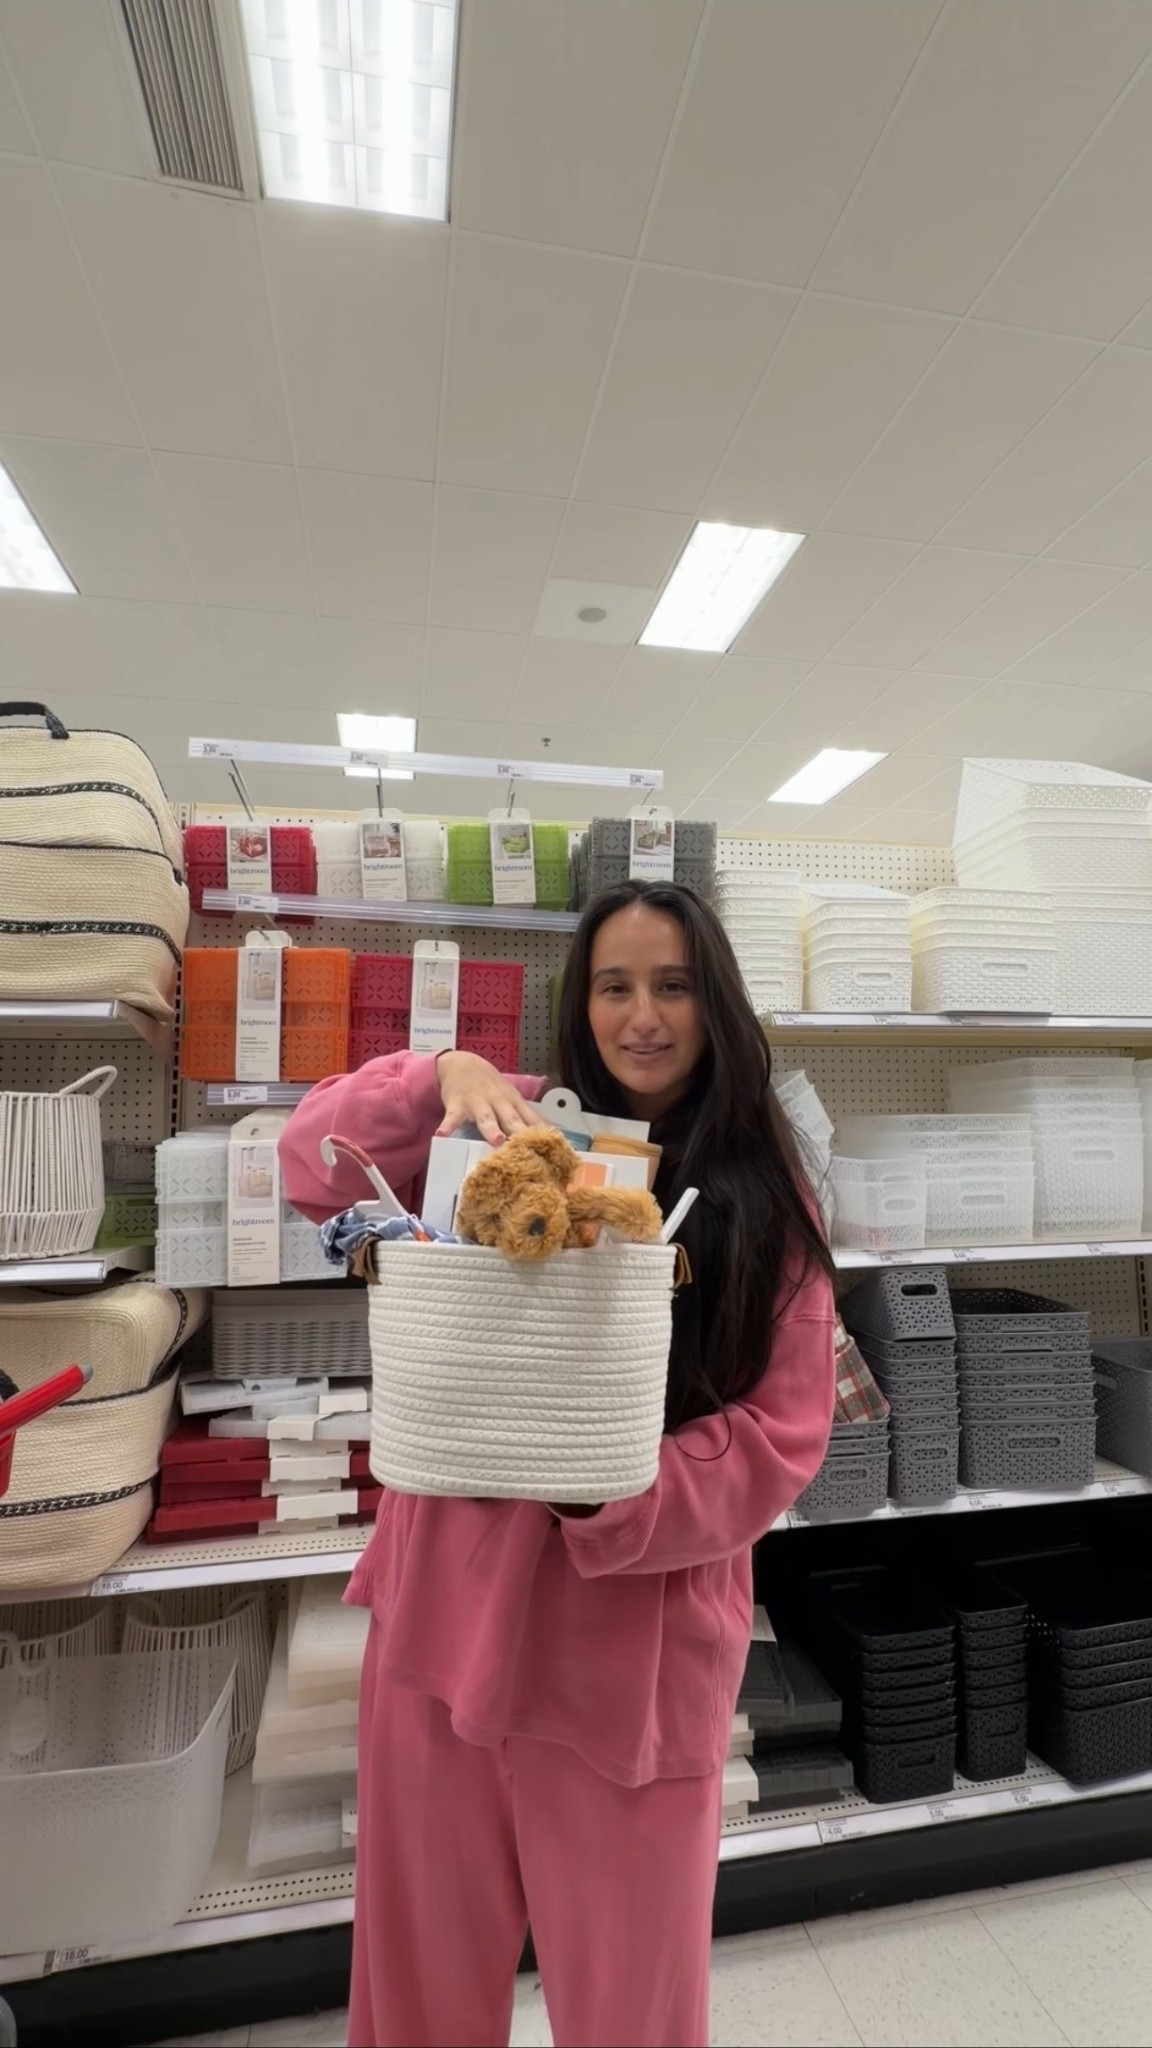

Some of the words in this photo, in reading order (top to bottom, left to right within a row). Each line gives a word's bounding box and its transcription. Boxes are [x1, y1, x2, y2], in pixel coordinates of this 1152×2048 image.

[363, 862, 403, 871] brightroom
[494, 863, 533, 872] brightroom
[632, 860, 672, 869] brightroom
[230, 866, 269, 875] brightroom
[240, 1019, 276, 1027] brightroom
[414, 1027, 452, 1035] brightroom
[232, 1218, 275, 1227] brightroom
[102, 1581, 124, 1590] 18.00
[828, 1826, 842, 1835] 4.00
[65, 1948, 89, 1960] 18.00
